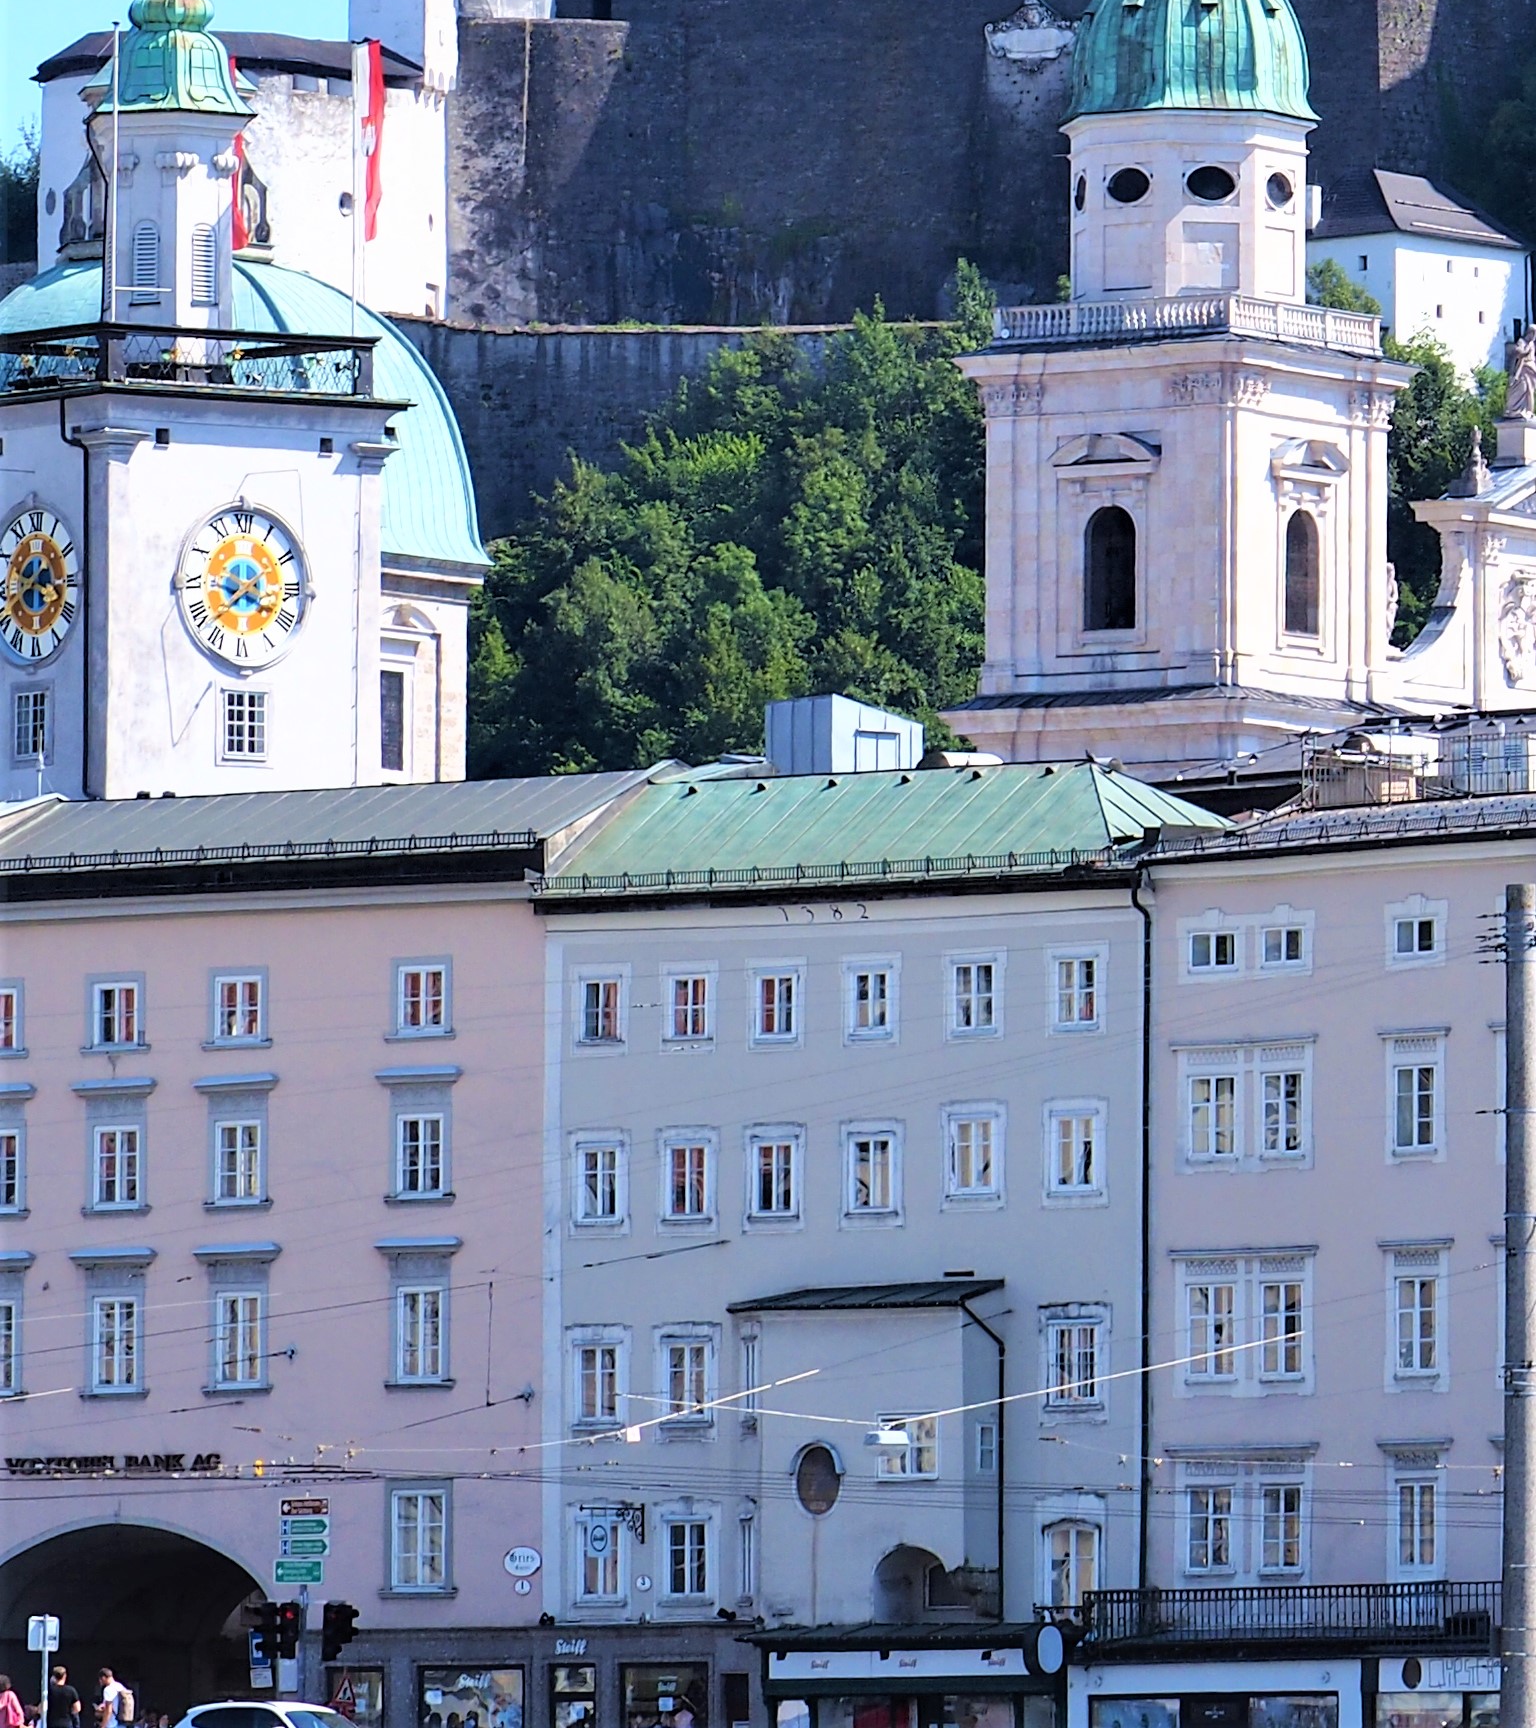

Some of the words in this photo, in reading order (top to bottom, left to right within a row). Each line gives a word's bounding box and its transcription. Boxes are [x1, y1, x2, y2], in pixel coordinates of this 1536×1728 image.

[124, 1454, 186, 1472] BANK
[190, 1454, 221, 1472] AG
[554, 1638, 587, 1655] Steiff
[458, 1673, 491, 1689] Steiff
